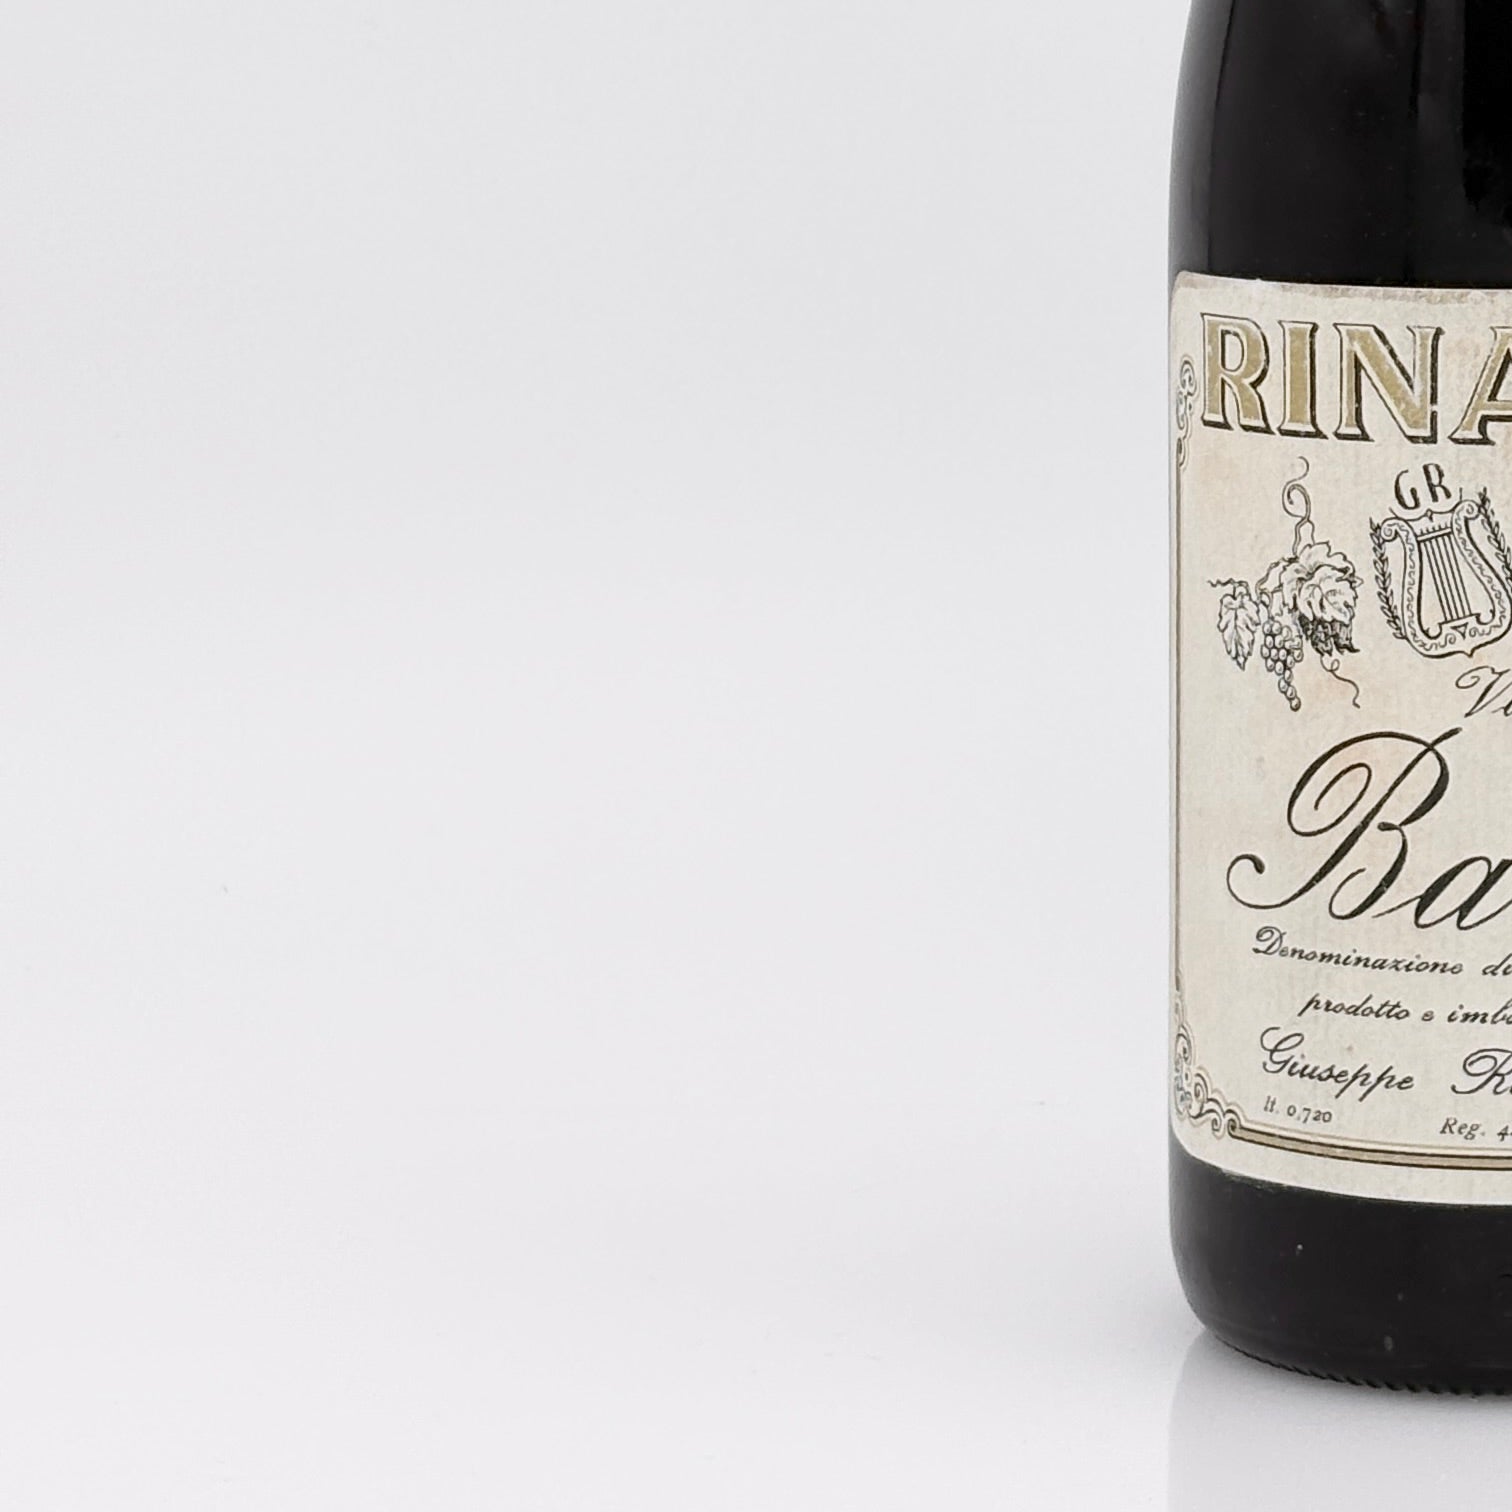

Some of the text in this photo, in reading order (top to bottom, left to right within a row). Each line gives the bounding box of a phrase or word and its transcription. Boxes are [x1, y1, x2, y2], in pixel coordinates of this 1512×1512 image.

[1393, 462, 1452, 510] GR
[1252, 926, 1463, 975] Denominazione
[1298, 993, 1410, 1021] prodotto
[1421, 1010, 1434, 1022] e
[1260, 1027, 1415, 1102] Giuseppe
[1439, 1116, 1486, 1141] Reg.
